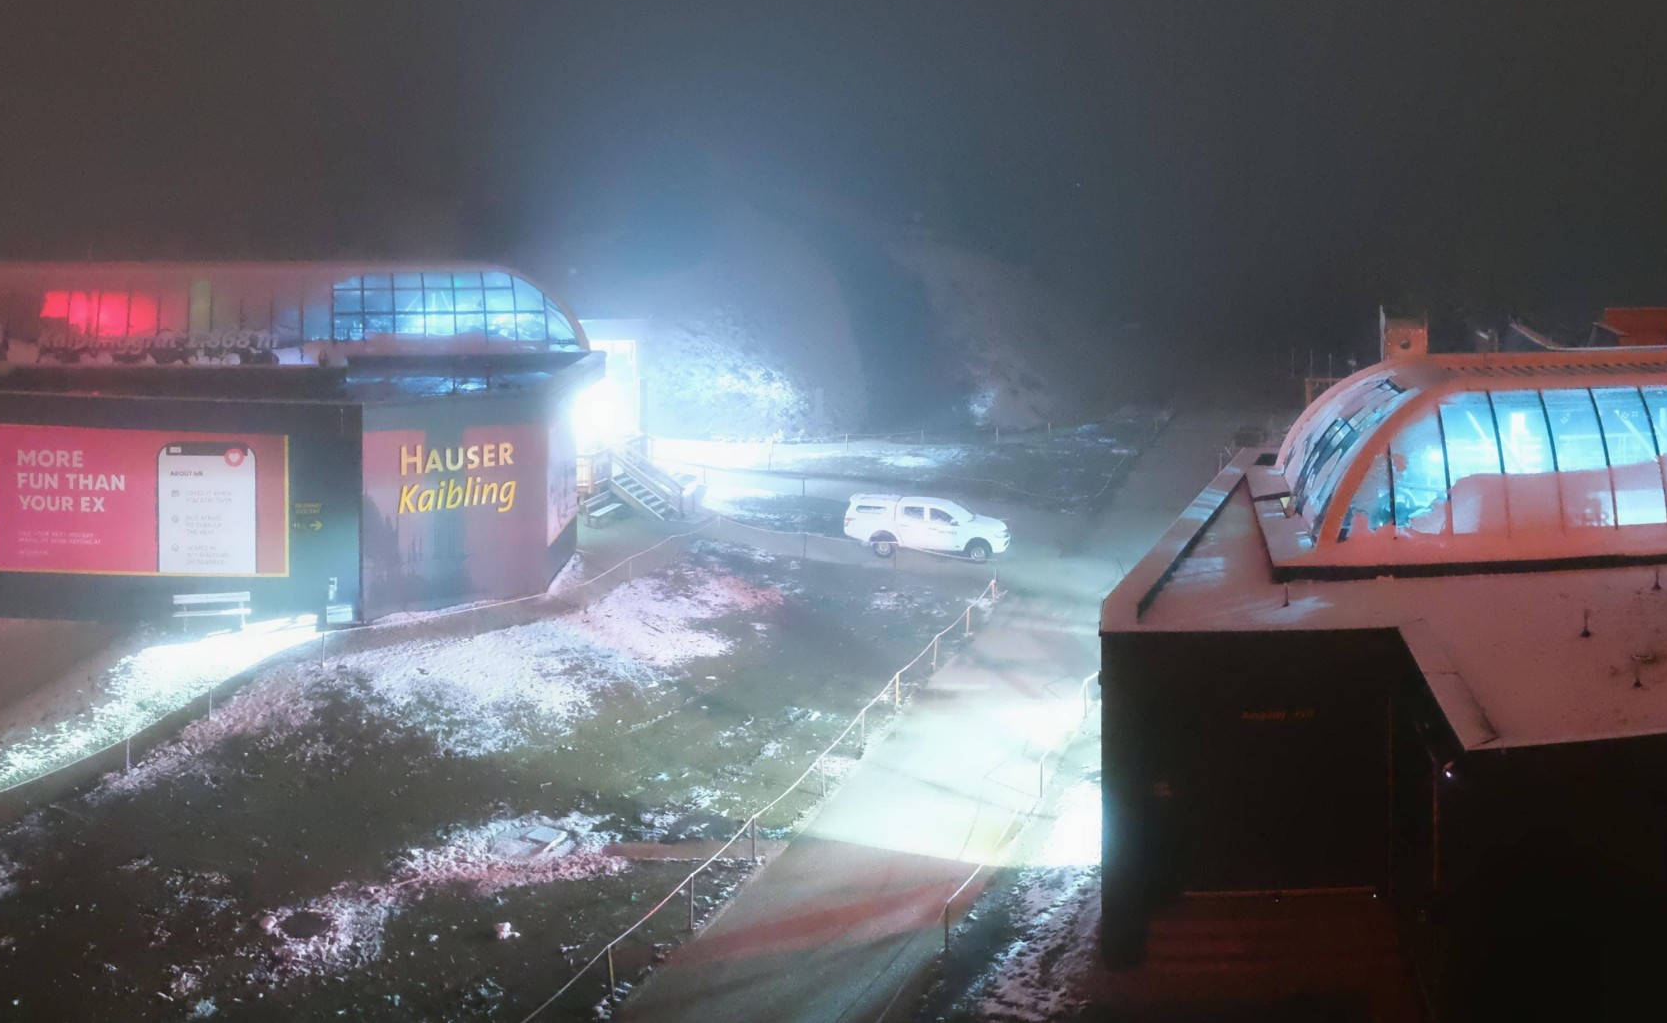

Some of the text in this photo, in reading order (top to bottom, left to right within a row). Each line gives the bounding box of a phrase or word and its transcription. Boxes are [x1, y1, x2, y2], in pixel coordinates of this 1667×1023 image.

[17, 449, 84, 468] MORE
[400, 442, 515, 476] HAUSER
[17, 472, 126, 491] FUN THAN
[19, 495, 106, 513] YOUR EX
[398, 476, 517, 514] Kaibling
